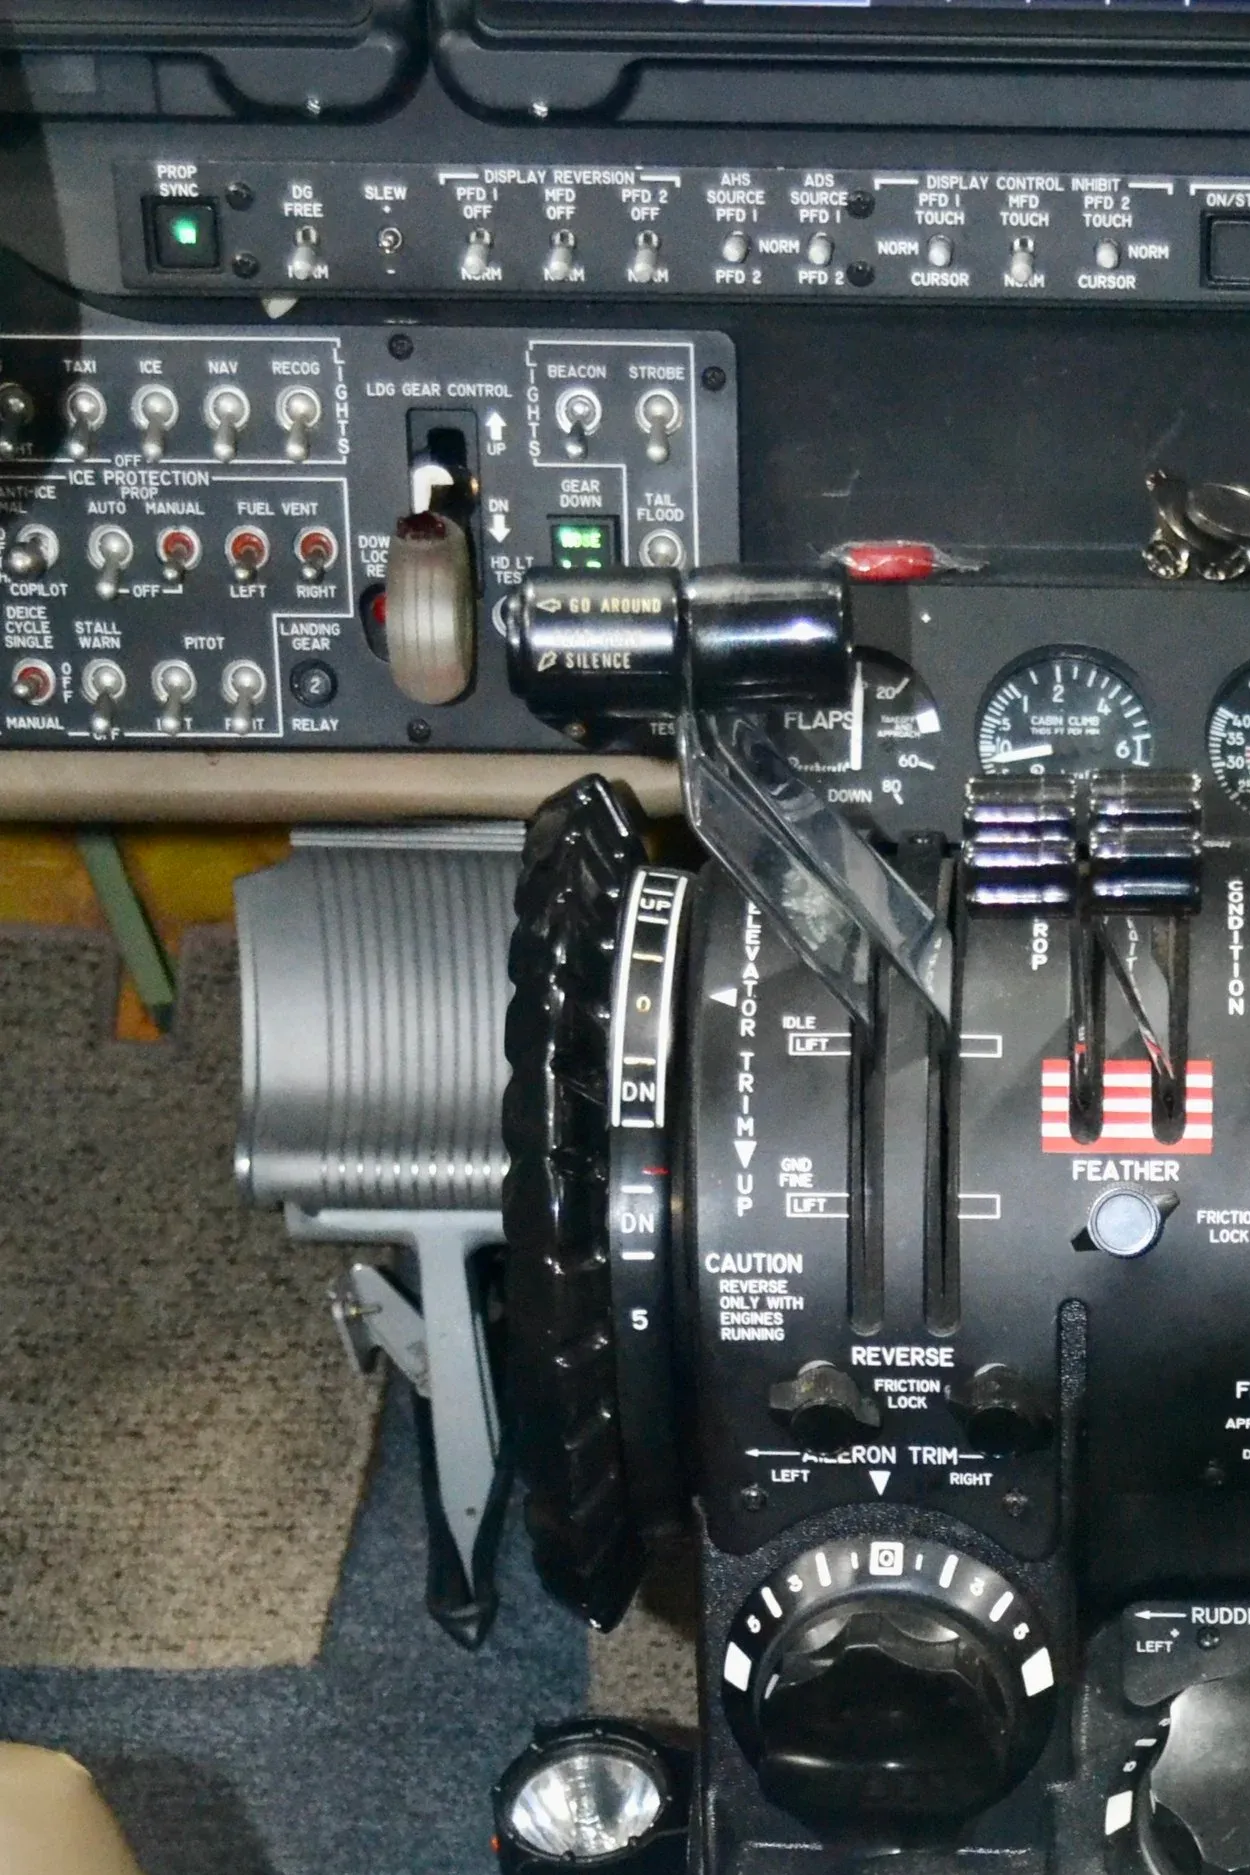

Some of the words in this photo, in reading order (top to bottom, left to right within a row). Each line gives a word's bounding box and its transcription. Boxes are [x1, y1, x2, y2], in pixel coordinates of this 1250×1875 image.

[158, 165, 197, 179] PROP
[485, 170, 547, 184] DISPLAY
[554, 171, 635, 185] REVERSION
[160, 184, 199, 197] SYNC
[927, 176, 988, 189] DISPLAY
[996, 177, 1064, 191] CONTROL
[1072, 178, 1121, 192] INHIBIT
[365, 187, 407, 199] SLEW
[707, 191, 765, 205] SOURCE
[791, 192, 847, 205] SOURCE
[284, 203, 323, 217] FREE
[916, 212, 964, 225] TOUCH
[1001, 213, 1049, 227] TOUCH
[1085, 214, 1132, 228] TOUCH
[759, 240, 799, 254] NORM
[878, 242, 918, 256] NORM
[1128, 245, 1169, 259] NORM
[911, 273, 969, 287] CURSOR
[1078, 275, 1136, 289] CURSOR
[208, 361, 238, 374] NAV
[272, 361, 320, 376] RECOG
[548, 365, 606, 378] BEACON
[629, 366, 685, 380] STROBE
[367, 383, 395, 397] LDG
[402, 383, 441, 397] GEAR
[447, 384, 512, 398] CONTROL
[68, 470, 95, 486] ICE
[104, 471, 209, 486] PROTECTION
[121, 486, 159, 500] PROP
[562, 480, 599, 493] GEAR
[560, 494, 601, 508] DOWN
[645, 494, 676, 507] TAIL
[88, 503, 126, 516] AUTO
[146, 503, 205, 516] MANUAL
[237, 503, 275, 516] FUEL
[282, 503, 318, 516] VENT
[637, 508, 684, 521] FLOOD
[230, 585, 266, 598] LEFT
[296, 585, 336, 598] RIGHT
[569, 598, 591, 613] GO
[602, 598, 661, 613] AROUND
[75, 622, 121, 635] STALL
[280, 624, 340, 637] LANDING
[79, 636, 121, 649] WARN
[292, 638, 330, 651] GEAR
[566, 653, 631, 669] SILENCE
[877, 686, 896, 700] 20
[292, 720, 339, 731] RELAY
[784, 711, 855, 730] FLAPS
[899, 754, 918, 768] 60
[828, 789, 872, 803] DOWN
[640, 898, 671, 912] UP
[782, 1016, 816, 1030] IDLE
[795, 1038, 829, 1051] LIFT
[622, 1082, 655, 1101] DN
[781, 1158, 812, 1172] GND
[1073, 1160, 1179, 1182] FEATHER
[779, 1174, 813, 1188] FINE
[793, 1200, 826, 1212] LIFT
[621, 1213, 654, 1233] DN
[1209, 1230, 1249, 1243] LOCK
[705, 1253, 803, 1274] CAUTION
[720, 1280, 788, 1294] REVERSE
[720, 1295, 761, 1310] ONLY
[768, 1297, 803, 1310] WITH
[720, 1313, 784, 1326] ENGINES
[721, 1328, 785, 1341] RUNNING
[852, 1346, 954, 1368] REVERSE
[874, 1379, 940, 1393] FRICTION
[888, 1395, 927, 1409] LOCK
[909, 1446, 958, 1465] TRIM
[771, 1469, 810, 1483] LEFT
[950, 1472, 993, 1486] RIGHT
[1136, 1641, 1173, 1653] LEFT
